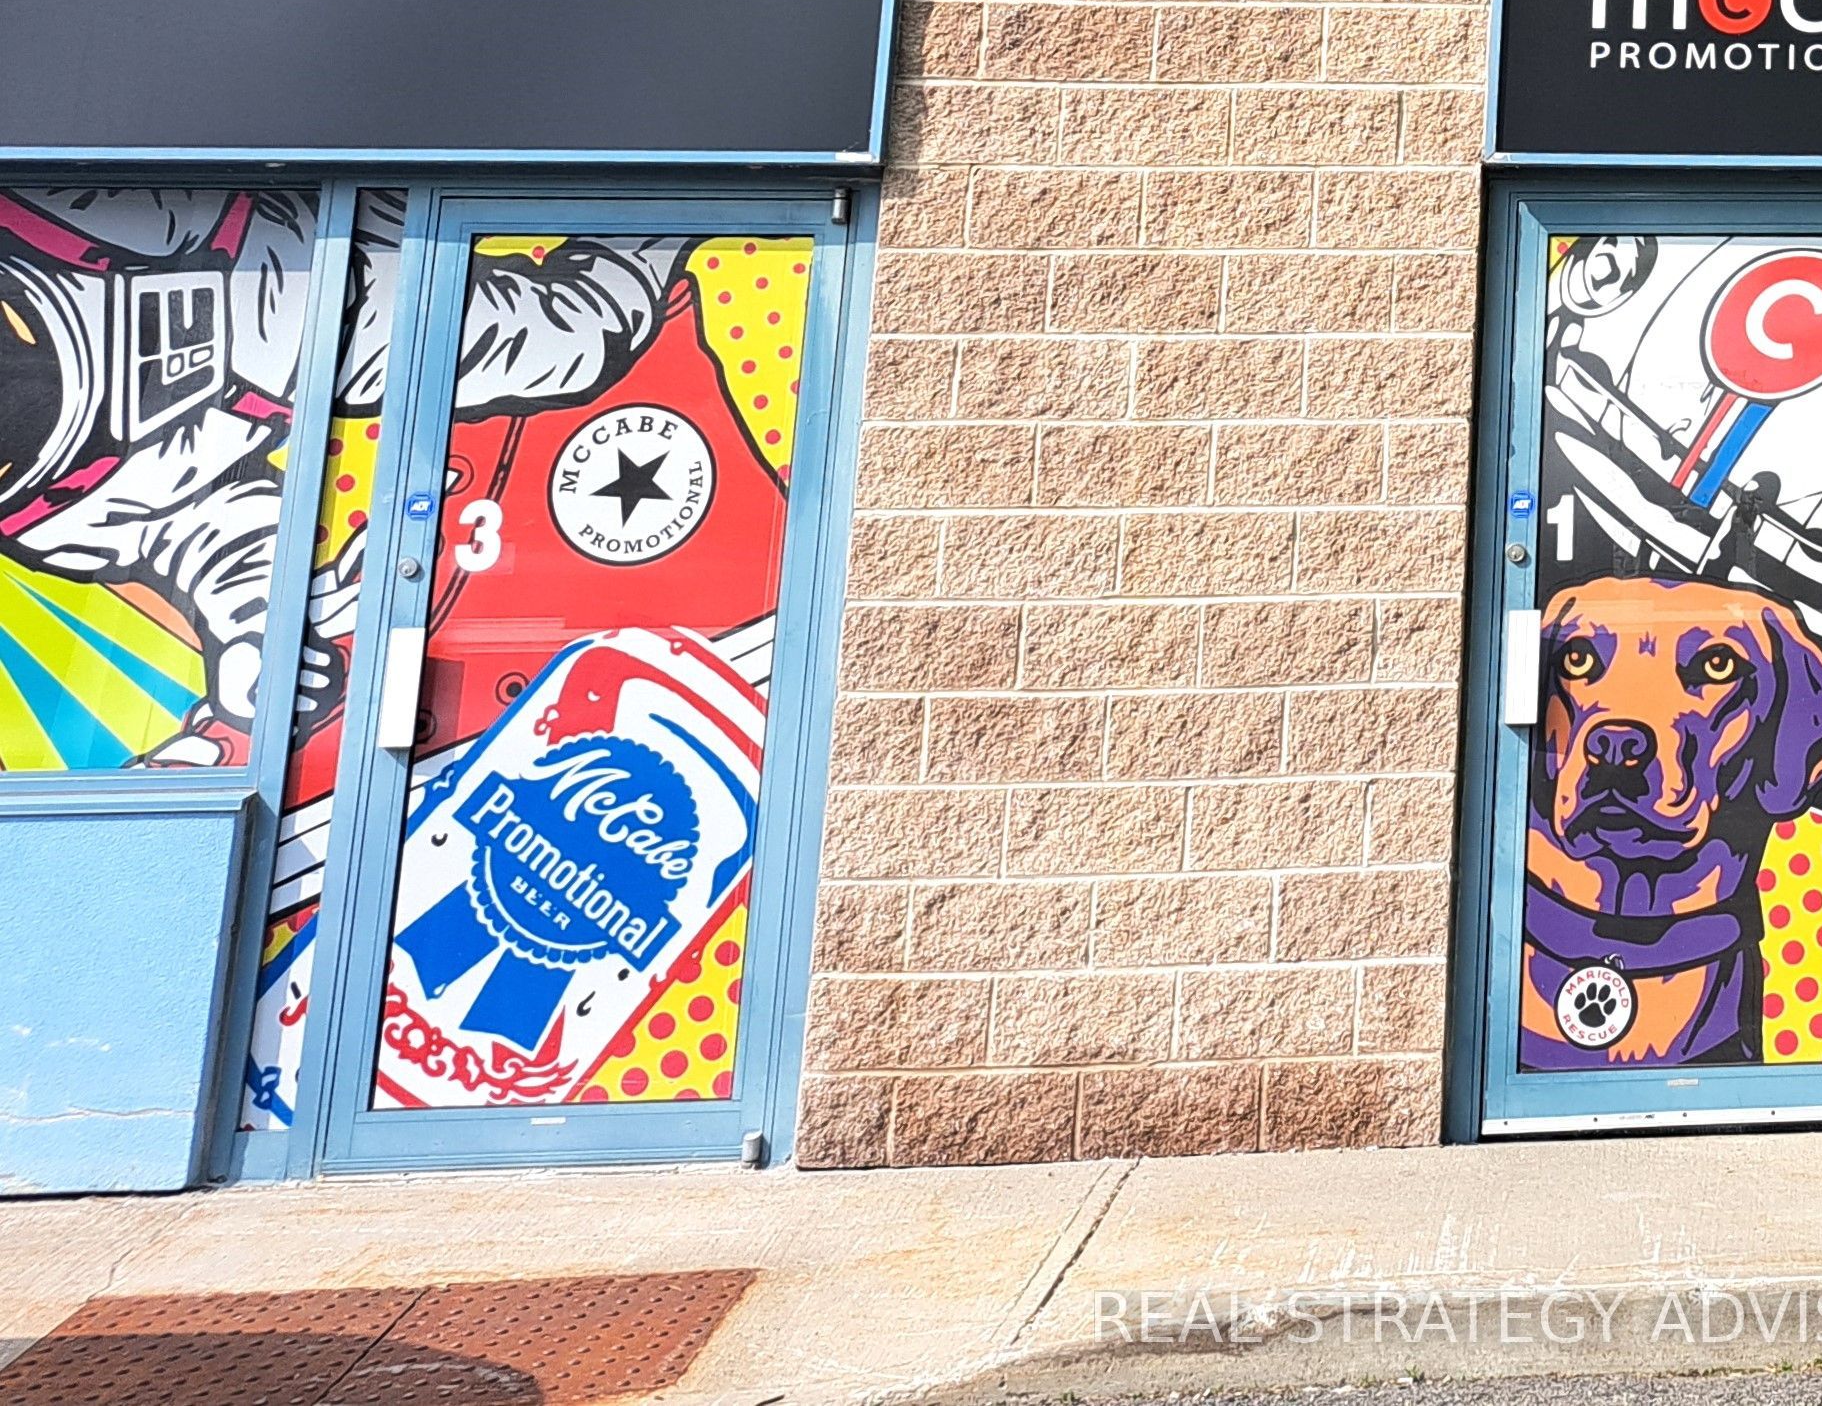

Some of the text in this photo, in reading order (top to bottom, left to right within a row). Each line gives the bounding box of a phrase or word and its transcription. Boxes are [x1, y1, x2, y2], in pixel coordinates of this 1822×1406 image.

[559, 415, 679, 494] MCCABE
[455, 499, 503, 572] 3
[578, 460, 704, 554] PROMOTIONAL
[1546, 494, 1574, 561] 1
[519, 748, 692, 880] McCabe
[470, 783, 668, 959] Promotional
[510, 876, 571, 930] BEER
[1565, 970, 1629, 1008] MARIGOLD
[1563, 1014, 1617, 1041] RESCUE
